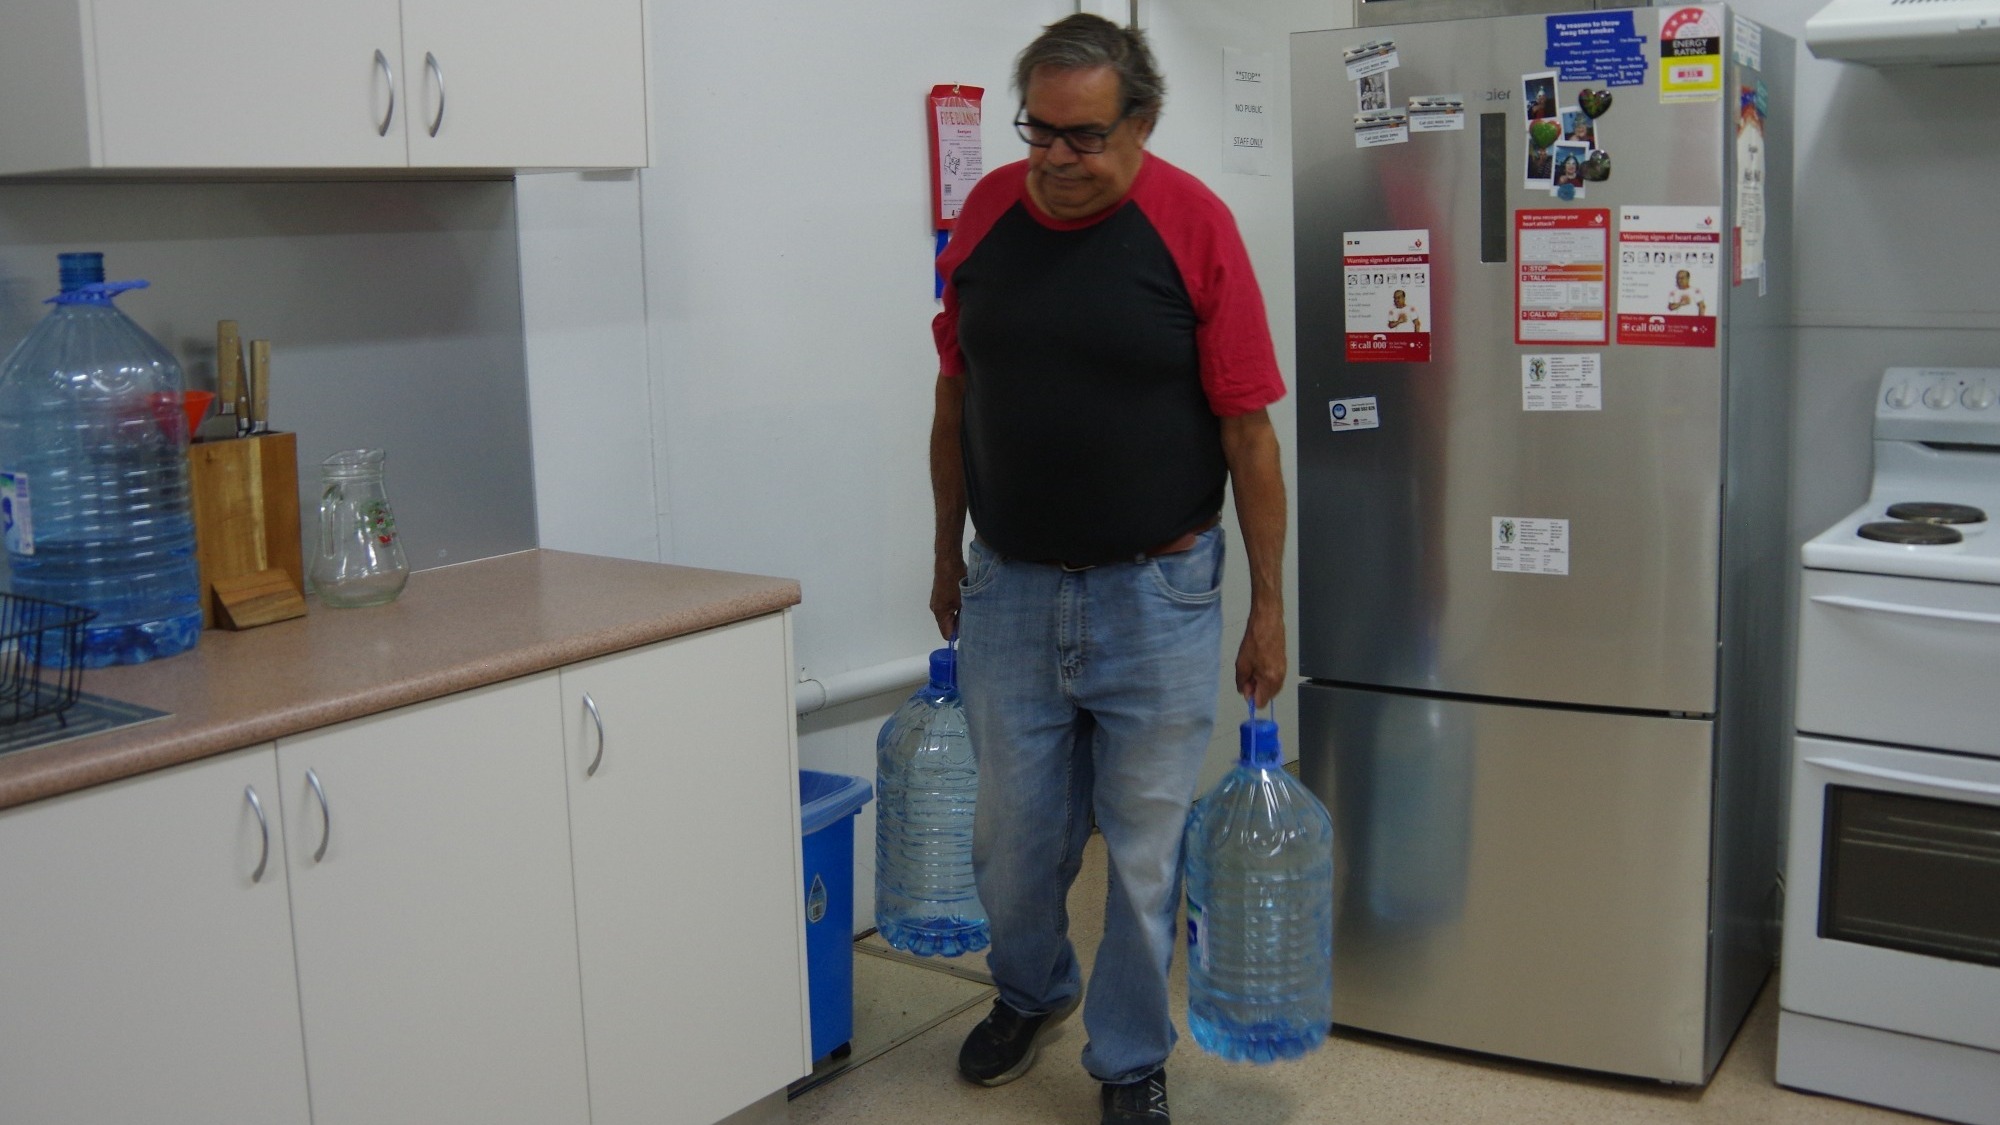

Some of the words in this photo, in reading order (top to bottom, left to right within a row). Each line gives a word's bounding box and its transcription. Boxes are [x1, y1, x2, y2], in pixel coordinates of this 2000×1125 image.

[1673, 39, 1708, 48] ENERGY
[1674, 48, 1707, 56] RATING
[1235, 104, 1243, 112] NO
[1245, 105, 1263, 113] PUBLIC
[1250, 138, 1263, 146] ONLY
[1650, 234, 1665, 242] signs
[1631, 323, 1647, 332] call
[1649, 324, 1665, 332] 000
[1358, 341, 1371, 349] call
